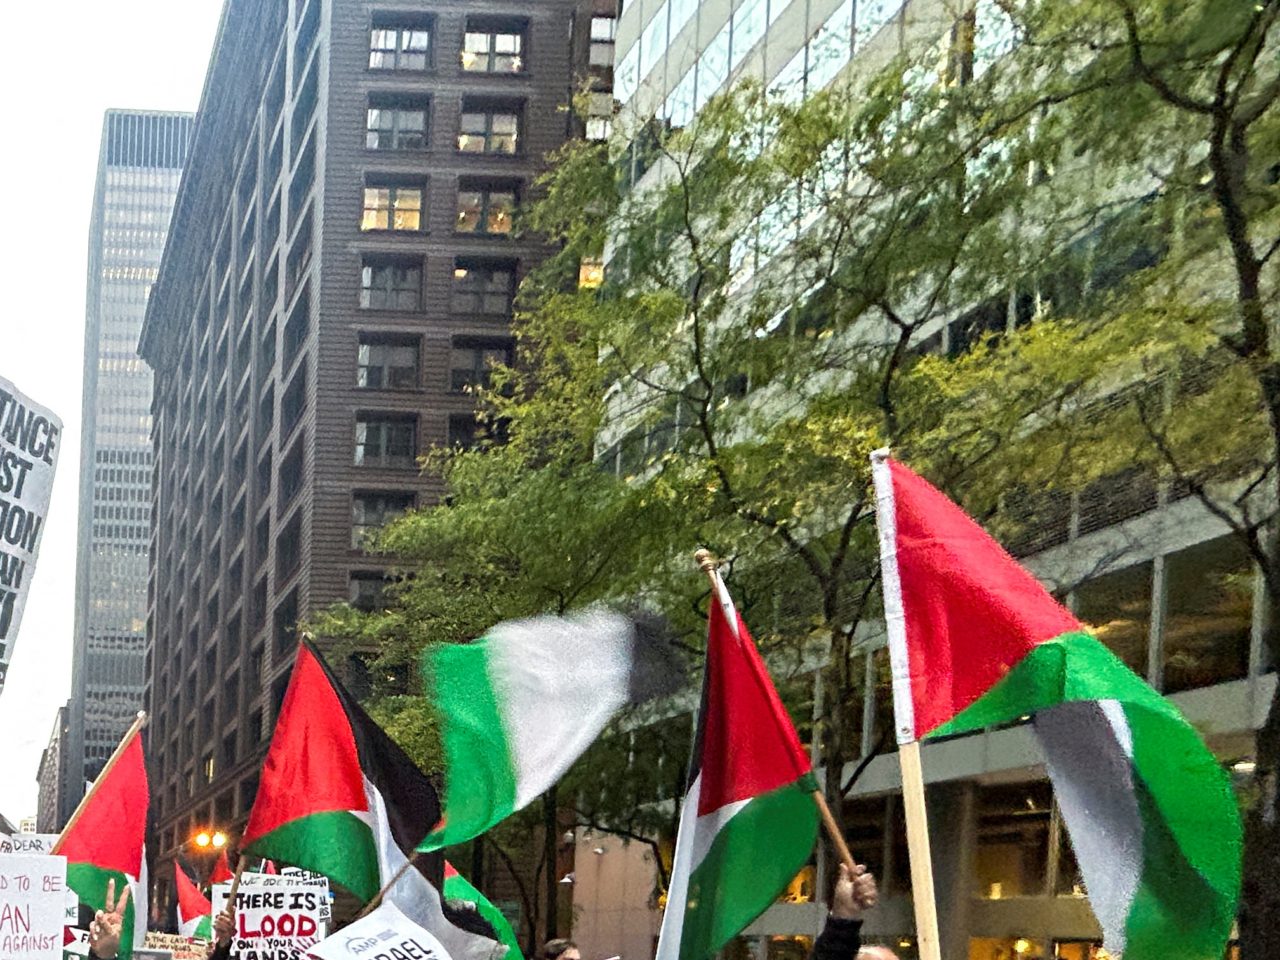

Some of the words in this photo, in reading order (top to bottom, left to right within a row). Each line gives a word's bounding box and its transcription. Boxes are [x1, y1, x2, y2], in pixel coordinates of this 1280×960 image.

[13, 839, 44, 851] DEAR
[14, 875, 30, 892] TO
[42, 875, 62, 892] BE
[289, 892, 317, 911] IS
[236, 913, 317, 939] LOOD
[3, 934, 59, 953] AGAINST
[237, 940, 254, 950] ON
[267, 938, 294, 948] YOUR
